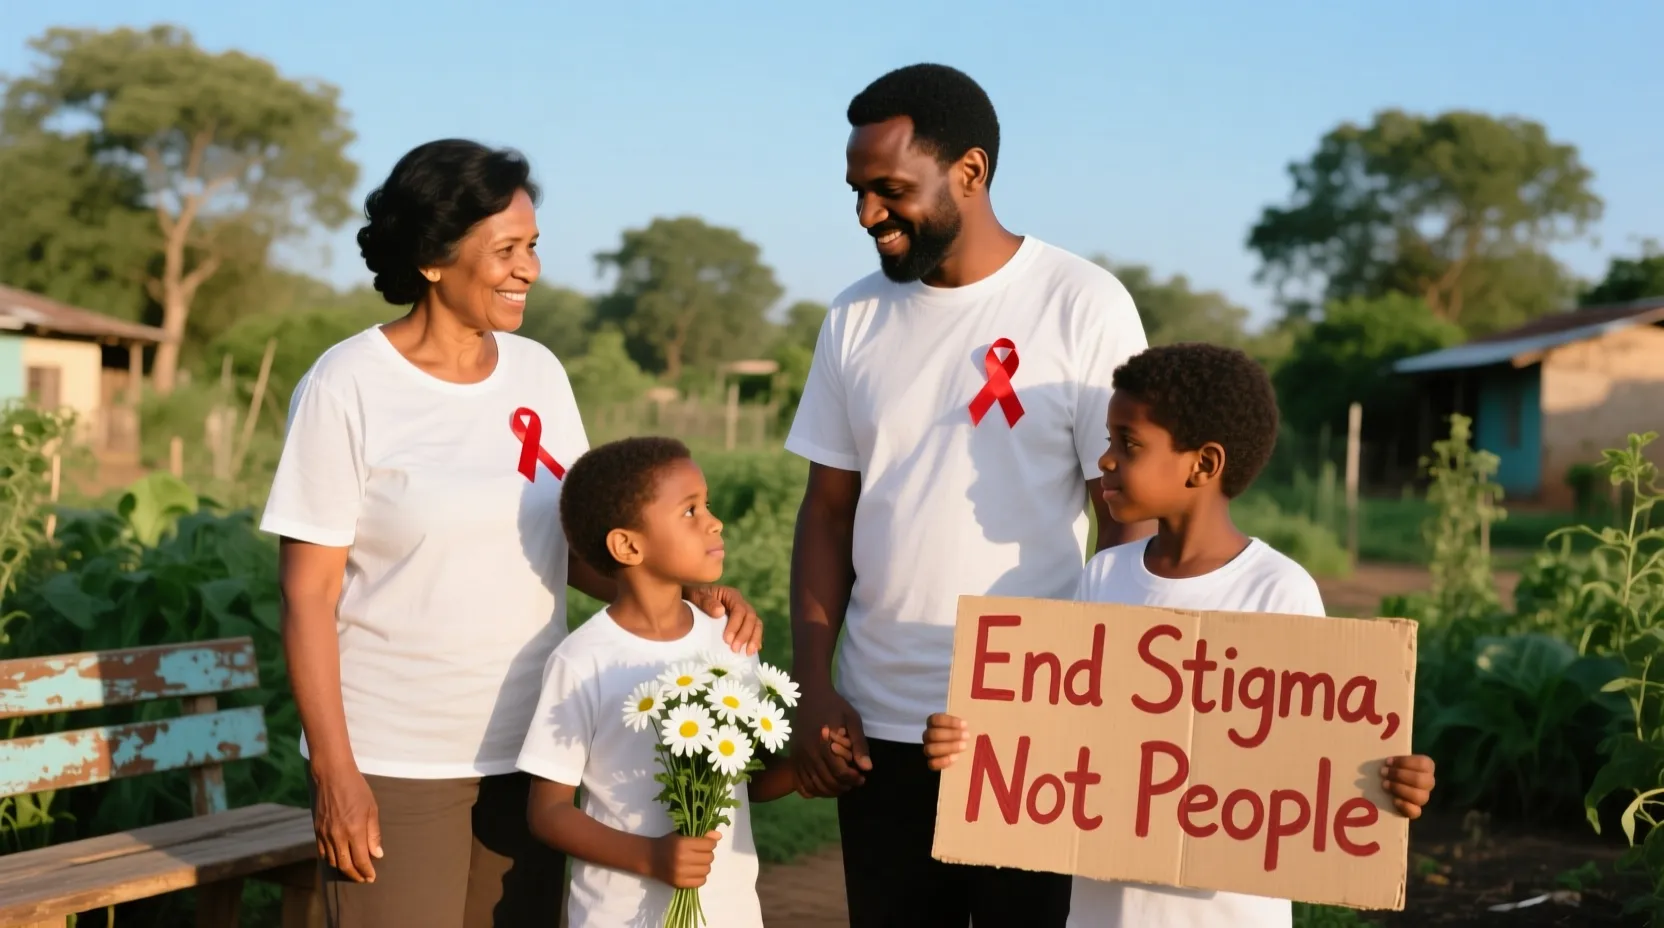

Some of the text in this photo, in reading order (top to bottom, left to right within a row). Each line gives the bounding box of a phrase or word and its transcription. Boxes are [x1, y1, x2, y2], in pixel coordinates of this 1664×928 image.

[971, 615, 1401, 749] End Stigma,
[965, 734, 1381, 872] Not People
